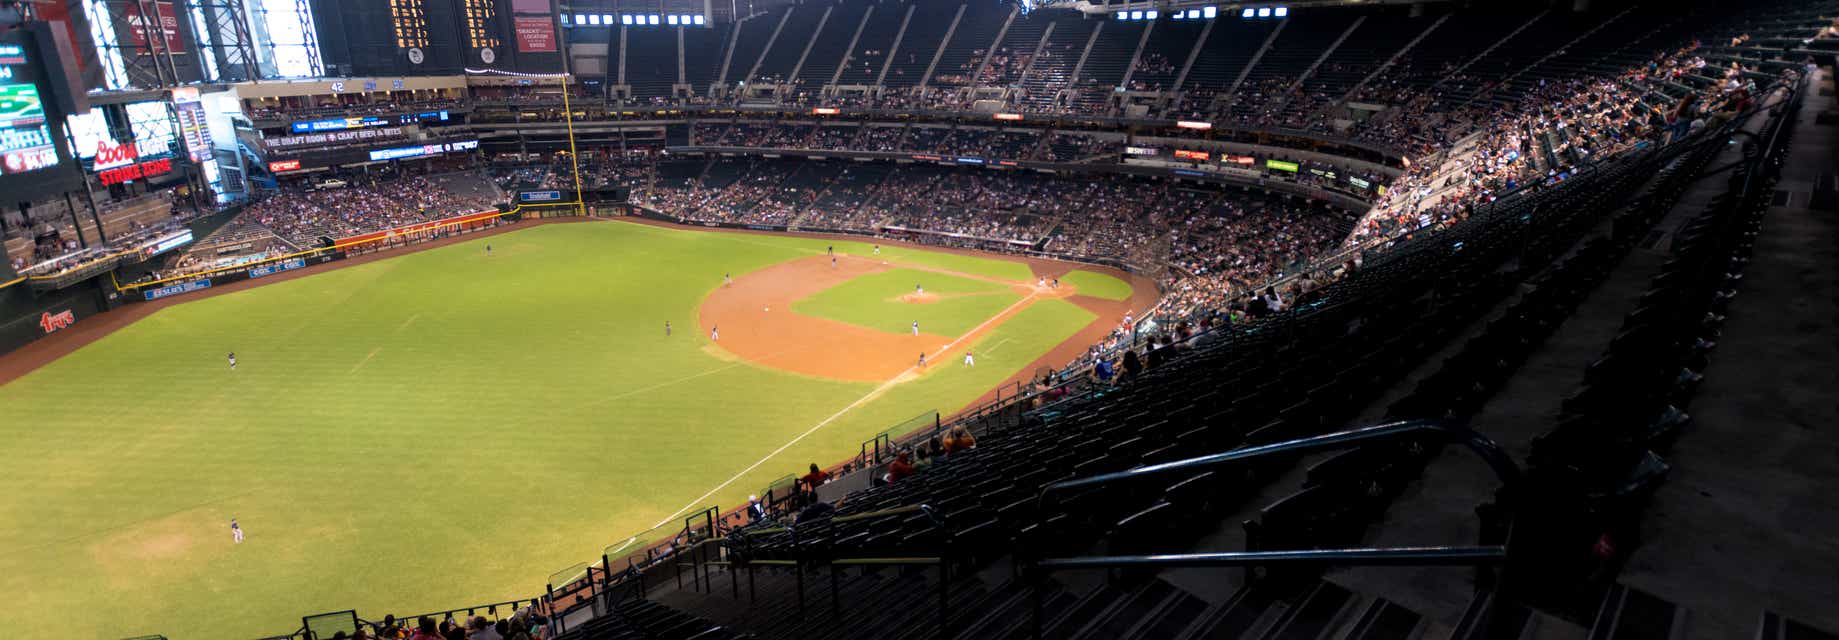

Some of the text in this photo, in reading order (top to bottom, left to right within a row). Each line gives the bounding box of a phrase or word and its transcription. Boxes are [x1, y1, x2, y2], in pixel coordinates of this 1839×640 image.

[331, 82, 344, 92] 42
[265, 137, 281, 147] THE
[281, 135, 305, 145] DRAFT
[305, 133, 327, 143] ROOM
[337, 130, 358, 141] CRAFT
[358, 129, 377, 138] BEER
[384, 126, 402, 136] BITES
[95, 140, 138, 165] Coors
[99, 158, 171, 186] STRIKE ZONE
[253, 266, 271, 277] COX
[284, 260, 300, 270] COX
